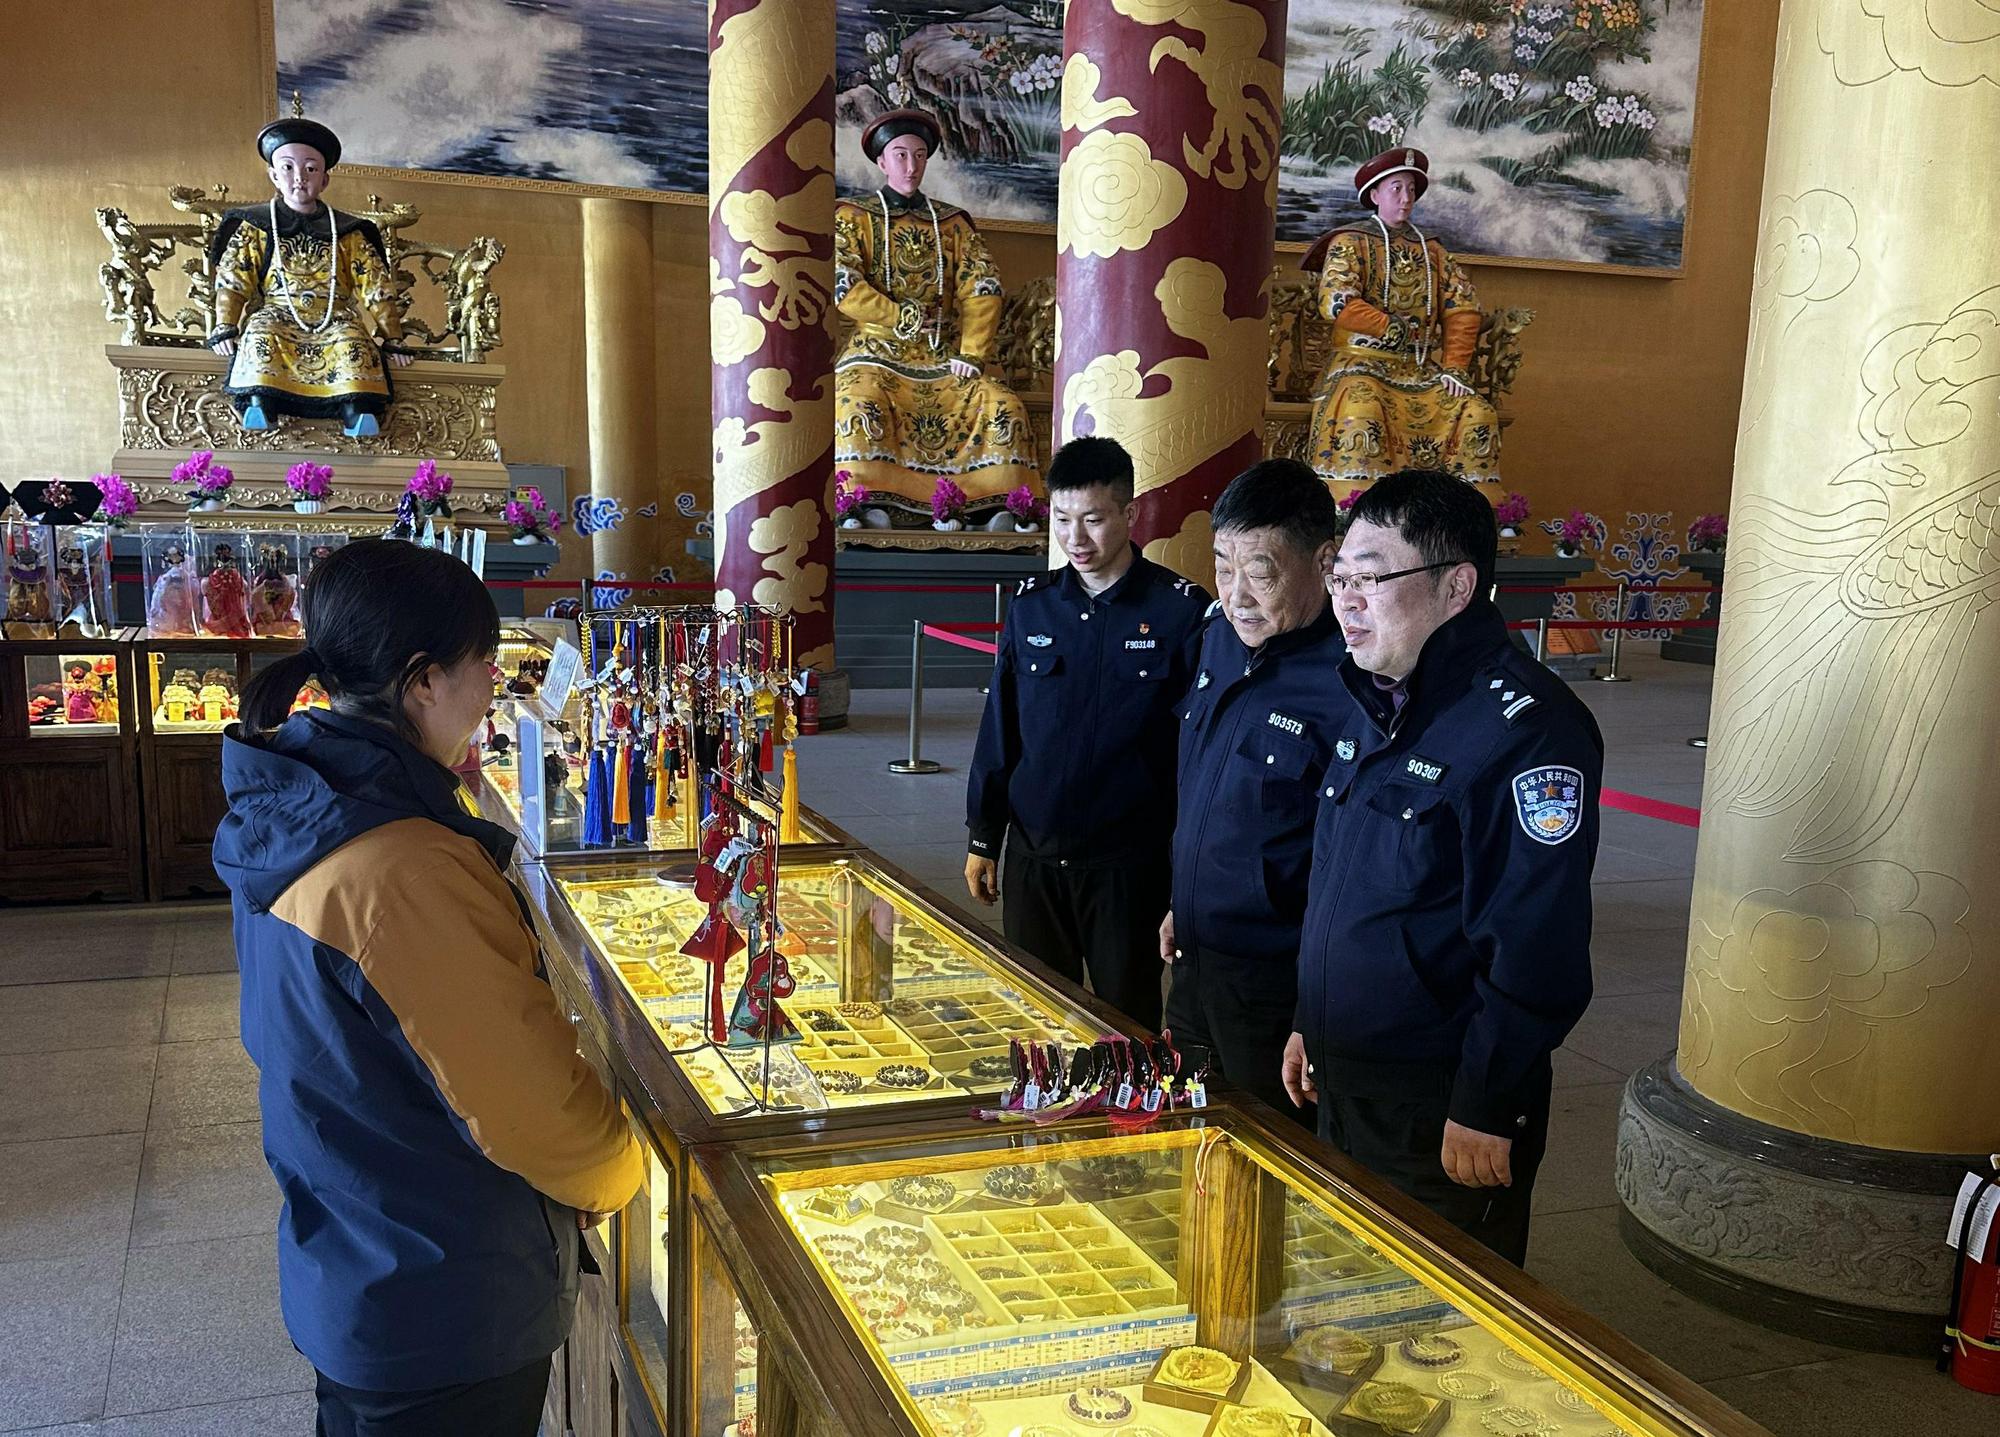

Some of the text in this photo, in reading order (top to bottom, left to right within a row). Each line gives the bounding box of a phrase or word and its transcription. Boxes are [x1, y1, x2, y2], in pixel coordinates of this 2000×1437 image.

[1268, 712, 1303, 735] 903573
[1519, 771, 1579, 791] 中华人民共和国
